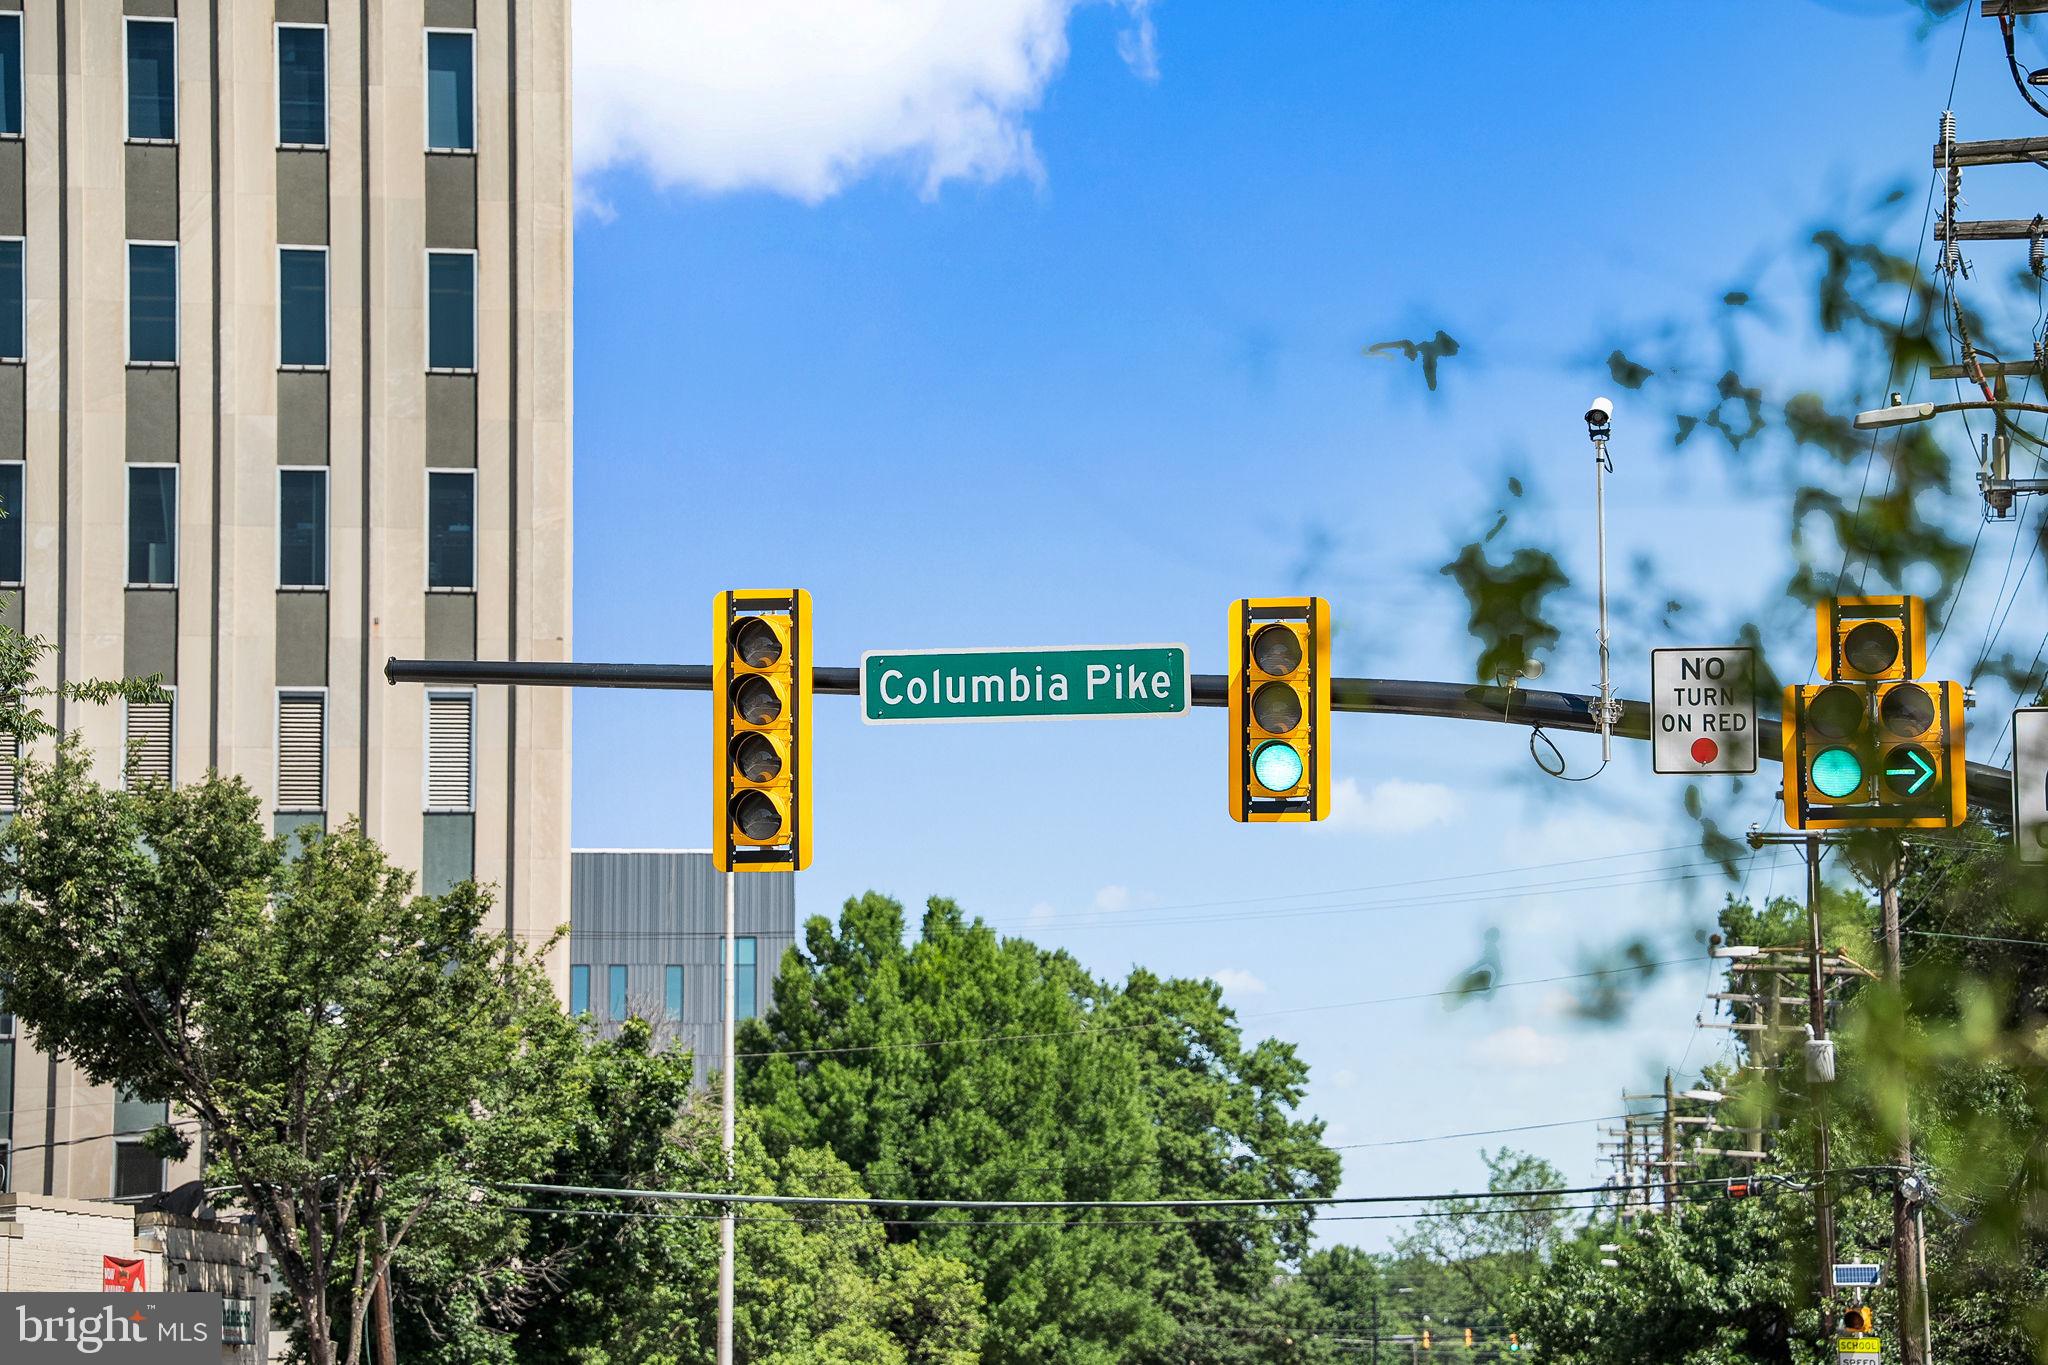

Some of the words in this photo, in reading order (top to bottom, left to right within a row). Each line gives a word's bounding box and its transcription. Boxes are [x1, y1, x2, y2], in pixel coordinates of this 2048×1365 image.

[1681, 657, 1725, 680] NO
[879, 666, 1068, 705] Columbia
[1086, 664, 1171, 700] Pike
[1673, 688, 1734, 706] TURN
[1661, 714, 1692, 732] ON
[1703, 713, 1747, 732] RED
[1840, 1341, 1877, 1350] SCHOOL
